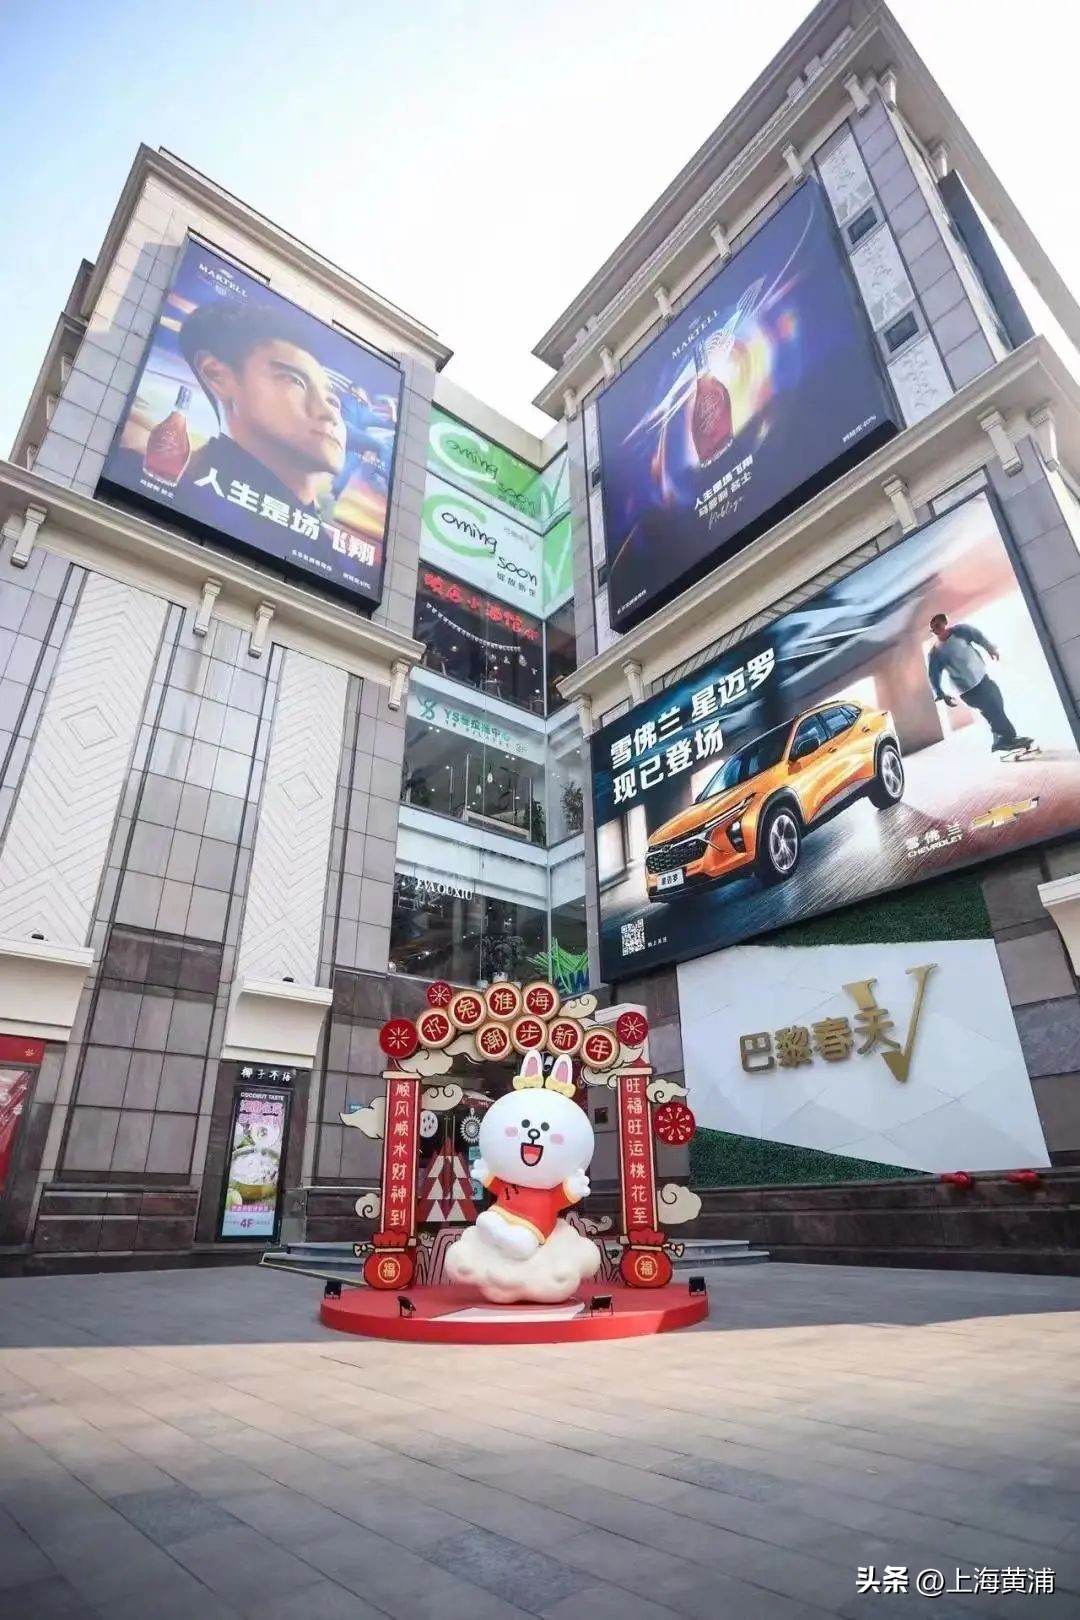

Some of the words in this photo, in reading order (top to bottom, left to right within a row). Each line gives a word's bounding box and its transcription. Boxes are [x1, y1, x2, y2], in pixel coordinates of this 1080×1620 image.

[194, 467, 376, 567] 人生是场飞翔
[610, 705, 682, 767] 雪佛兰
[690, 648, 775, 722] 星迈罗
[613, 723, 725, 804] 现已登场
[908, 834, 963, 858] CHEVROLET
[739, 1008, 900, 1073] 巴黎春天
[390, 1080, 411, 1226] 顺风顺水财神到
[625, 1078, 648, 1224] 旺福旺运桃花至
